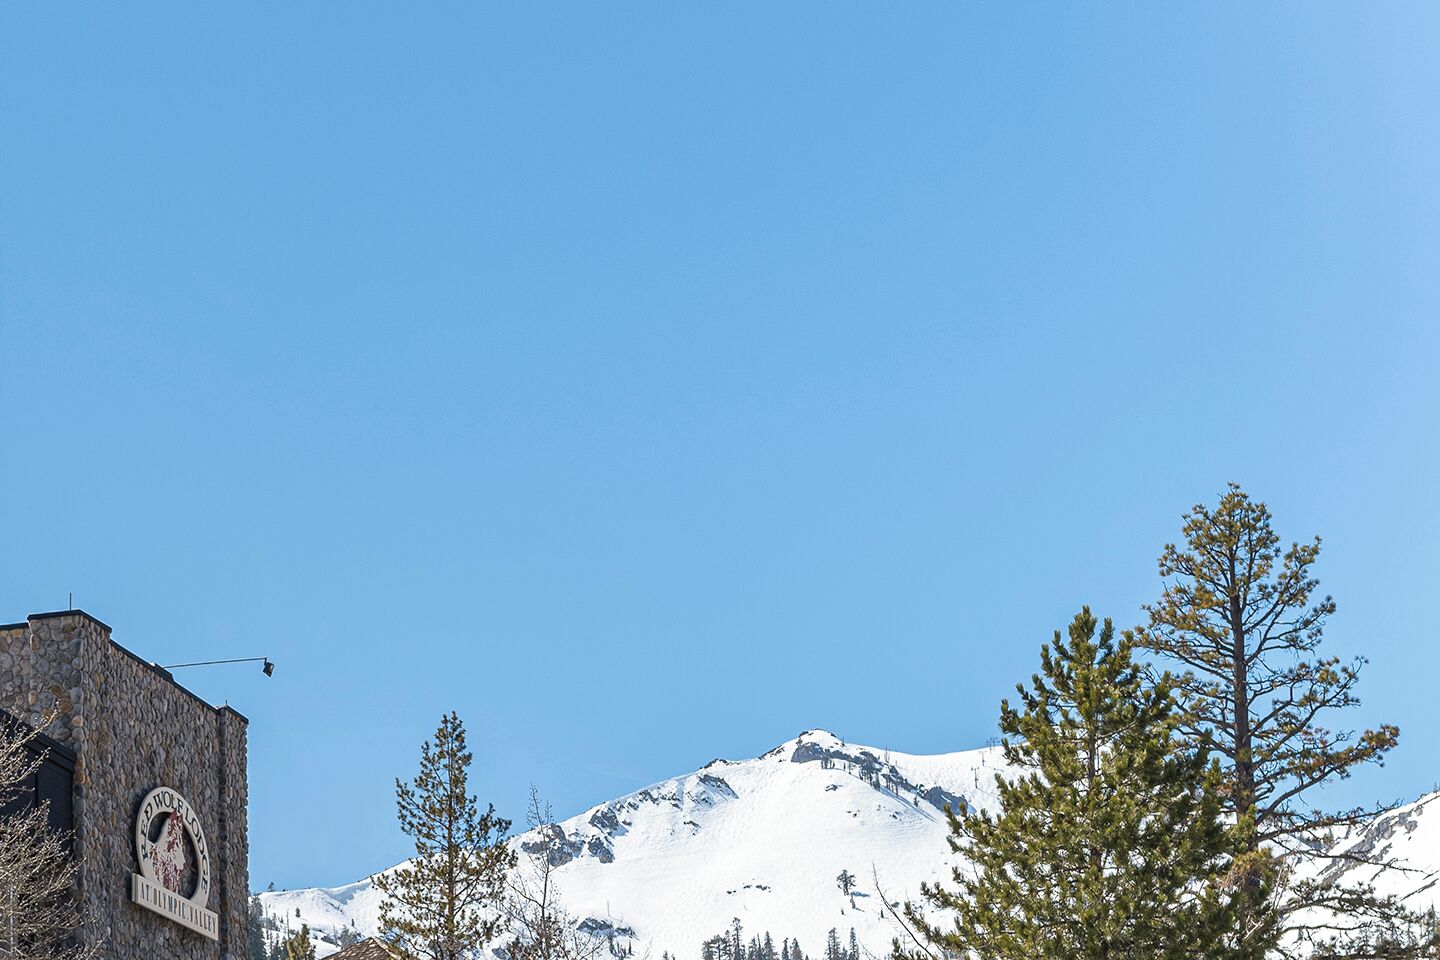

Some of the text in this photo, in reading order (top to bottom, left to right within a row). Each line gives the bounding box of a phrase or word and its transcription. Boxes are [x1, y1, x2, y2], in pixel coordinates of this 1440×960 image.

[140, 790, 209, 895] RED WOLF LODGE
[141, 882, 216, 934] AT OLYMPIC VALLEY
